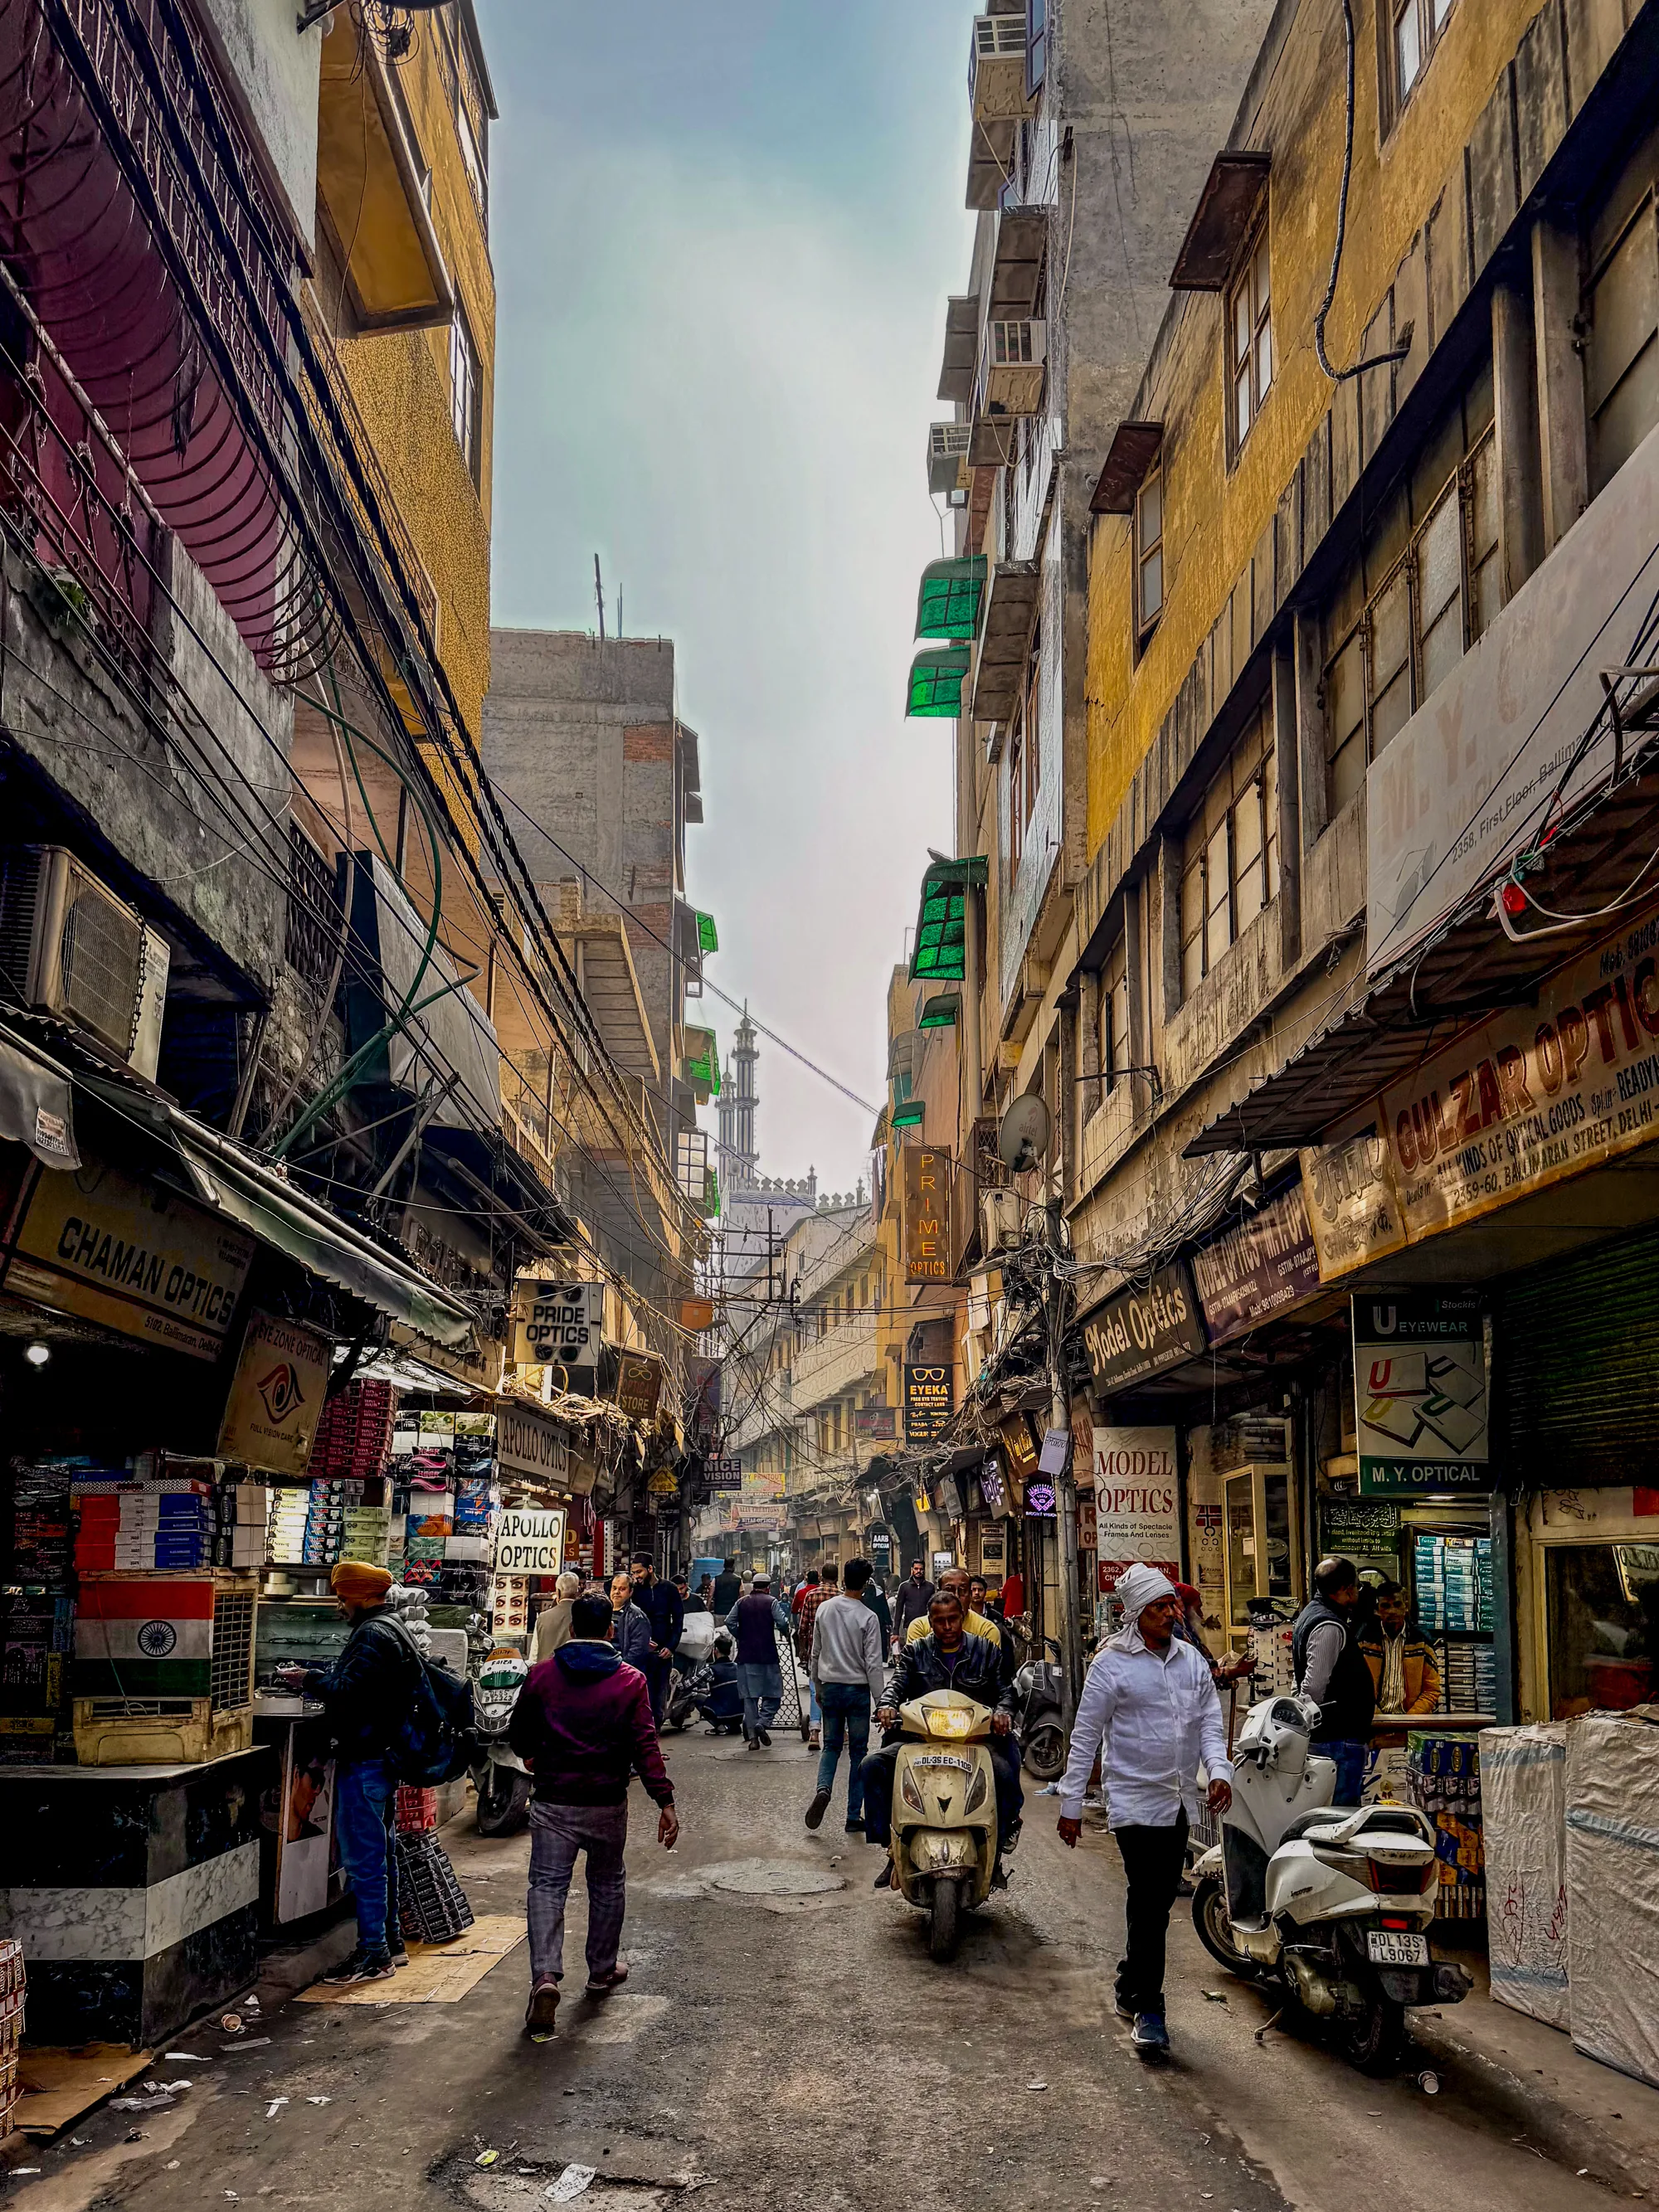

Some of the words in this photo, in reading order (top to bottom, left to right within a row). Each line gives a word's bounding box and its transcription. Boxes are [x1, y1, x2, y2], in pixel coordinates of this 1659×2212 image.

[1452, 834, 1477, 864] 2358,
[1479, 806, 1503, 839] First
[1397, 1044, 1536, 1174] GULZAR
[1019, 1121, 1038, 1137] airtel
[1454, 1144, 1487, 1179] KINDS
[1489, 1133, 1505, 1164] OF
[1506, 1116, 1550, 1156] OPTICAL
[1549, 1092, 1586, 1135] GOODS
[918, 1154, 938, 1256] PRIME
[57, 1216, 166, 1296] CHAMAN
[164, 1265, 236, 1326] OPTICS
[910, 1261, 945, 1276] OPTICS
[533, 1305, 586, 1325] PRIDE
[1372, 1305, 1397, 1334] U
[1399, 1320, 1468, 1334] EYEWEAR
[526, 1325, 589, 1345] OPTICS
[1084, 1306, 1132, 1376] Model
[1128, 1285, 1187, 1350] Optics
[296, 1341, 325, 1367] OPTICAL
[909, 1384, 948, 1395] EYEKA
[622, 1394, 649, 1412] STORE
[502, 1414, 539, 1463] APOLLO
[540, 1430, 567, 1473] OPTICS
[703, 1460, 740, 1472] NICE
[1097, 1450, 1174, 1476] MODEL
[703, 1472, 741, 1481] VISION
[1372, 1466, 1390, 1483] M.
[1394, 1466, 1408, 1483] Y.
[1411, 1466, 1481, 1483] OPTICAL
[1097, 1488, 1174, 1514] OPTICS
[500, 1514, 561, 1539] APOLLO
[1103, 1530, 1129, 1539] Frames
[1130, 1530, 1144, 1539] And
[1145, 1531, 1170, 1539] Lenses
[1108, 1523, 1129, 1531] Kinds
[1138, 1523, 1173, 1531] Spectacle
[873, 1534, 889, 1544] AARB
[500, 1544, 557, 1569] OPTICS
[1102, 1566, 1121, 1575] 2362,
[1380, 1949, 1421, 1963] L9067
